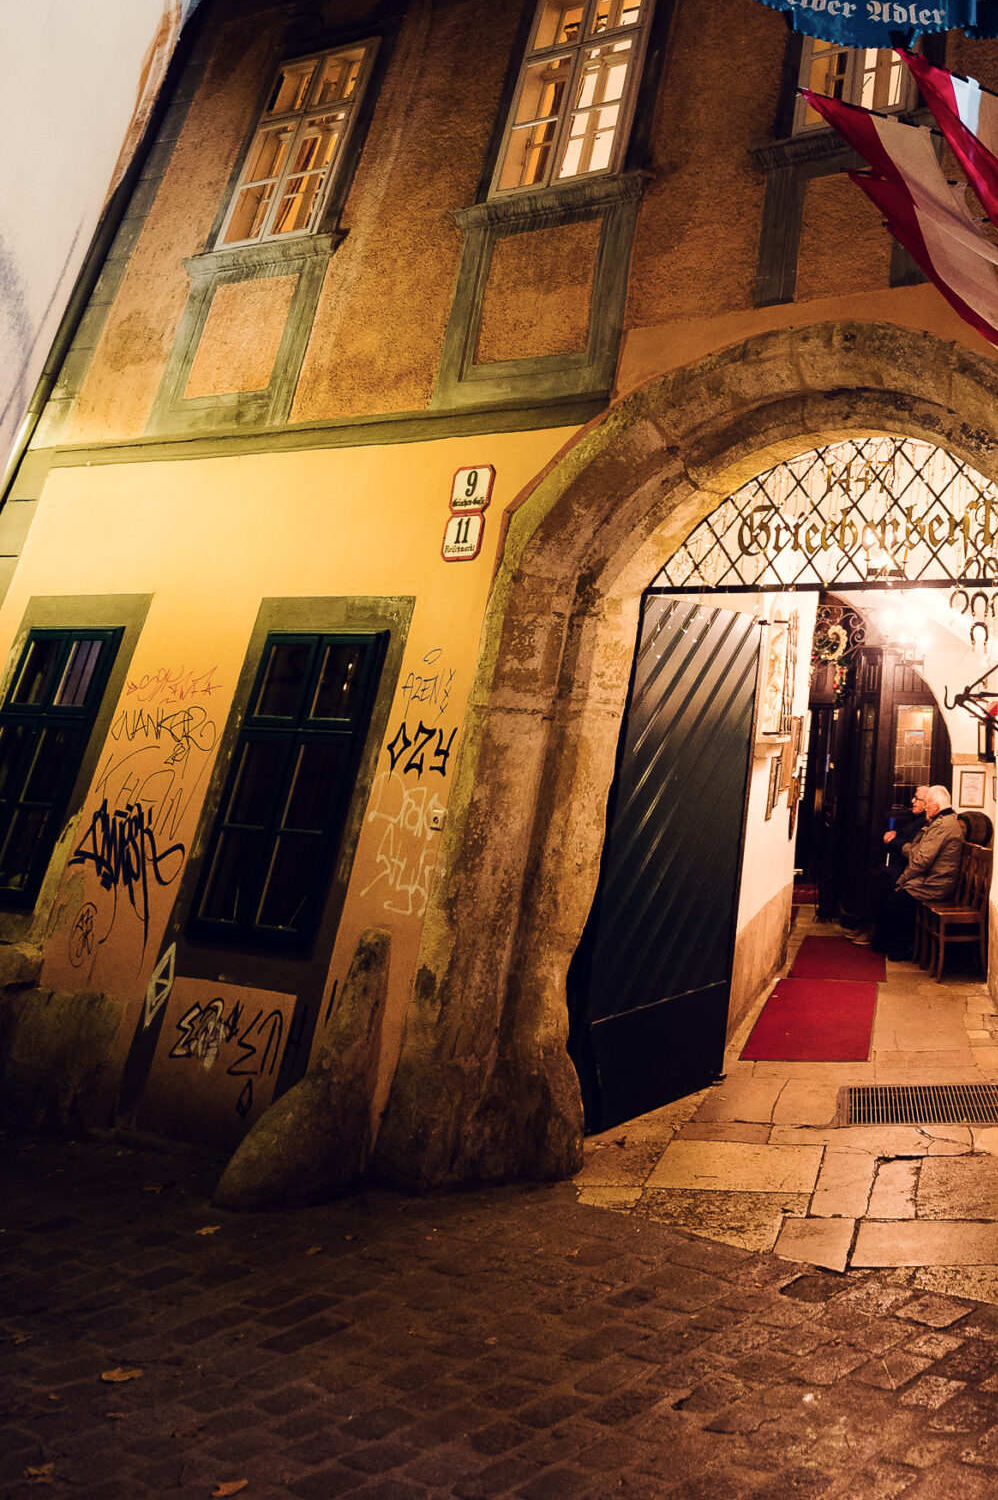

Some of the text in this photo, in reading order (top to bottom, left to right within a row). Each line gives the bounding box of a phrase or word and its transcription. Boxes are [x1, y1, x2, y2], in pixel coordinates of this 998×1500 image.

[866, 0, 946, 27] Adler
[465, 470, 478, 498] 9
[453, 517, 472, 545] 11
